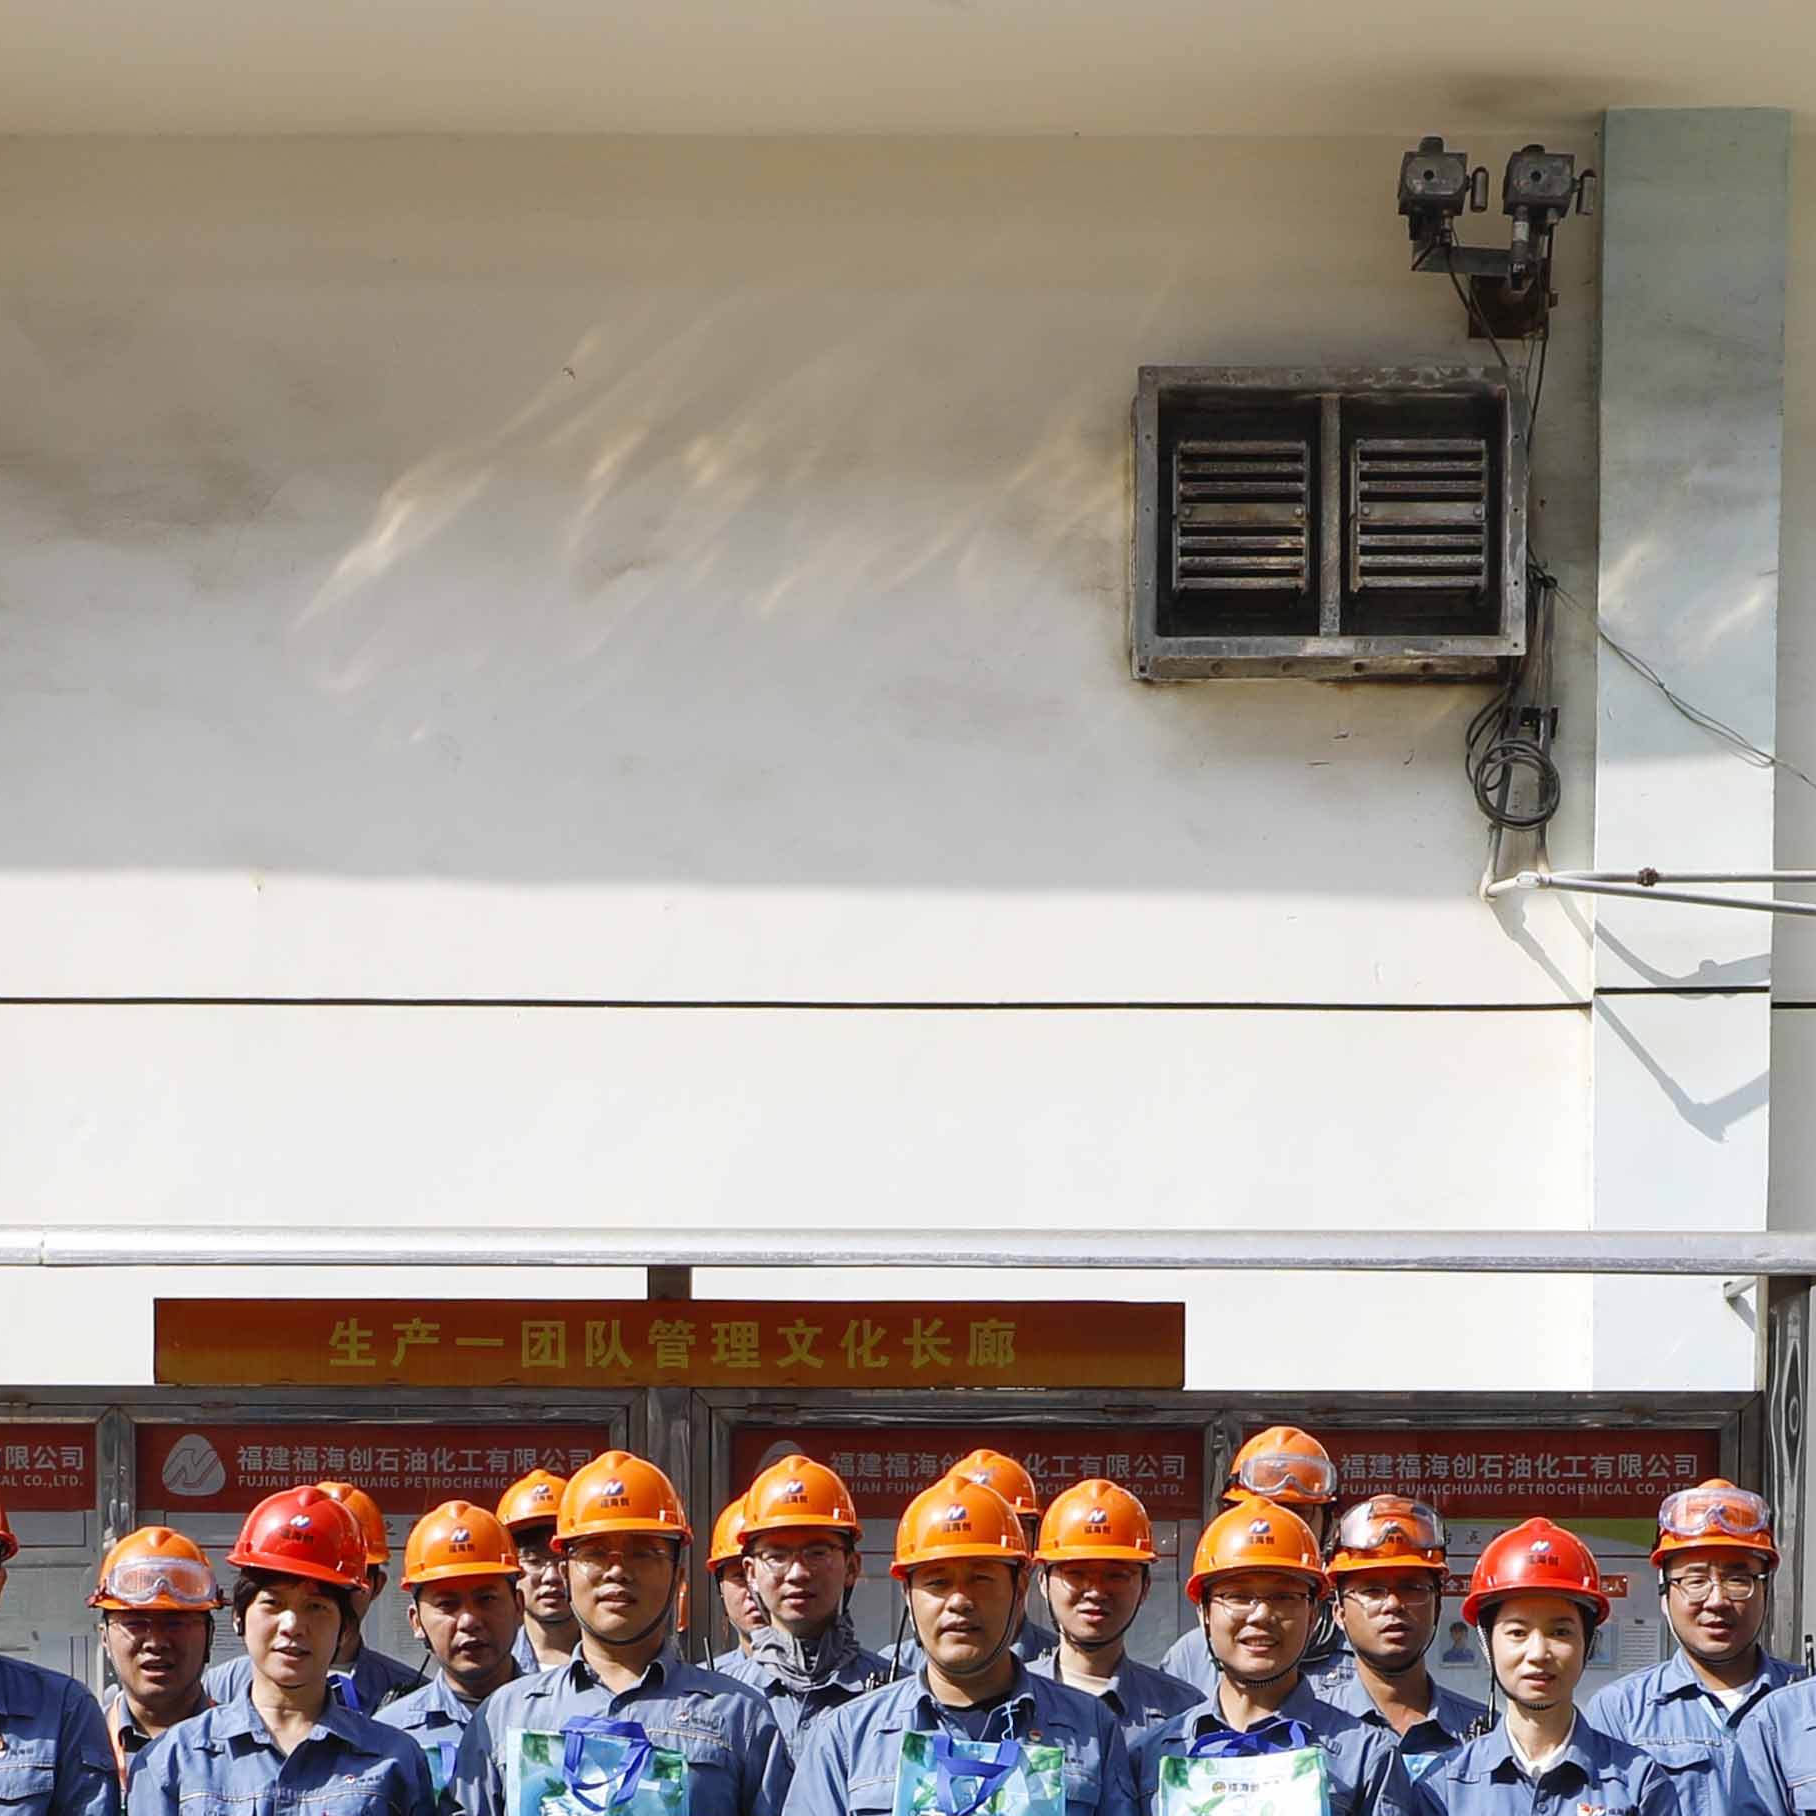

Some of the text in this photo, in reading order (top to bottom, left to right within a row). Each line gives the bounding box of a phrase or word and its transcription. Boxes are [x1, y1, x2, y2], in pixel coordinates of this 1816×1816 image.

[328, 1317, 1018, 1369] 生产一团队管理文化长廊
[236, 1445, 593, 1474] 福建福海创石油化工有限公司
[828, 1451, 1187, 1480] 福建福海化工有限公司
[1340, 1453, 1699, 1479] 福建福海创石油化工有限公司
[237, 1475, 288, 1489] FUJIAN
[403, 1475, 509, 1489] PETROCHEMIC
[1340, 1482, 1392, 1496] FUJIAN
[1396, 1482, 1504, 1496] FUHAICHUANG
[1508, 1482, 1630, 1496] PETROCHEMICAL
